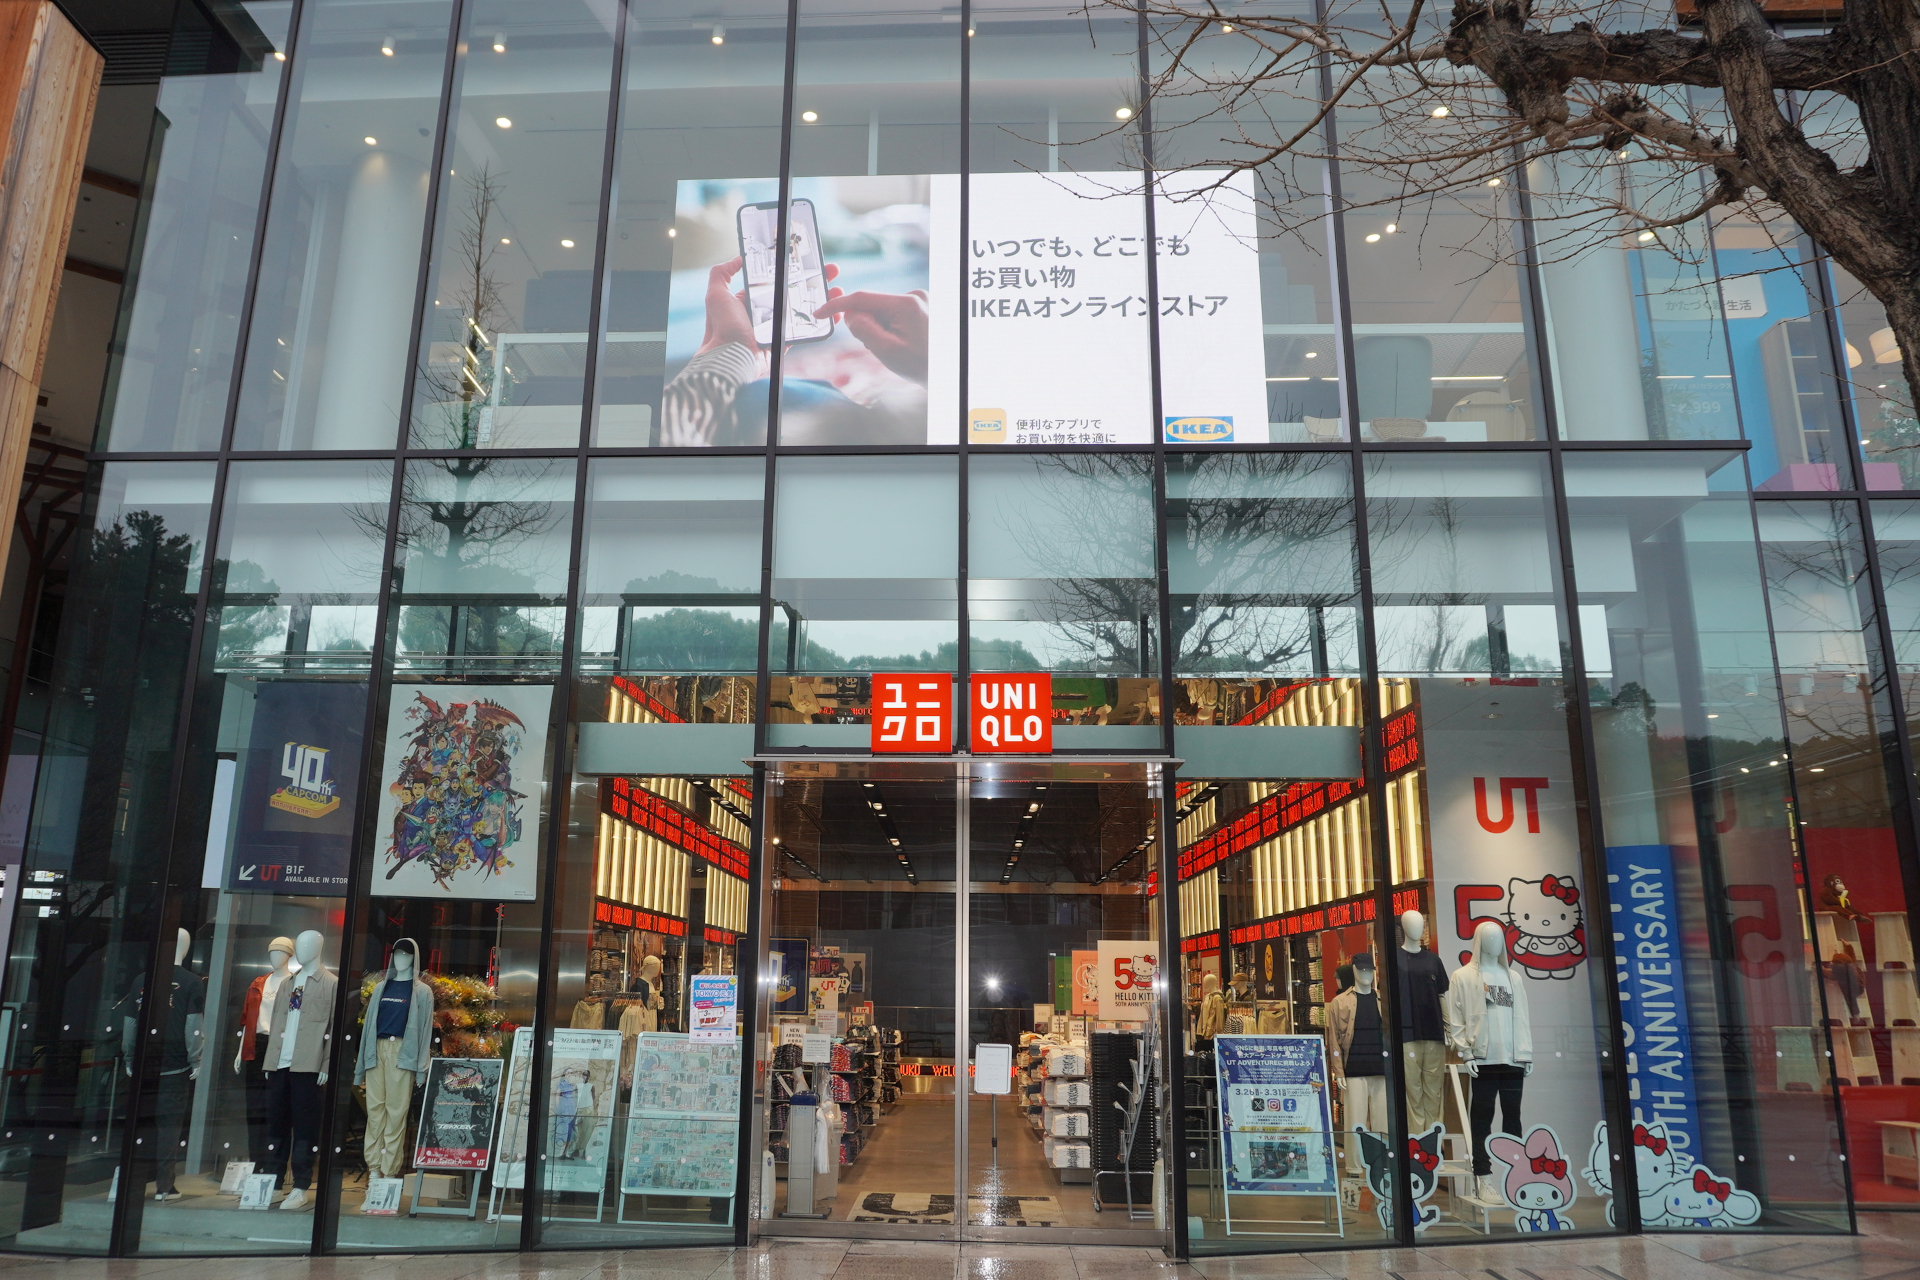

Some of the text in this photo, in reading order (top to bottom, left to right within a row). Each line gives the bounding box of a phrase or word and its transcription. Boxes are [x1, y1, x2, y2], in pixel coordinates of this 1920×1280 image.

[971, 266, 1076, 289] お買い物
[971, 294, 1229, 318] IKEAオンラインストア
[975, 422, 1000, 430] IKEA
[1016, 418, 1102, 430] 便利なアプリで
[1171, 423, 1229, 435] IKEA
[1016, 432, 1117, 444] お買い物を快適に
[286, 785, 327, 804] CAPCOM
[1473, 777, 1549, 834] UT
[260, 865, 282, 882] UT
[285, 865, 305, 875] B1F
[284, 876, 321, 884] AVAILABLE
[1628, 864, 1684, 1081] ANNIVERSARY
[1115, 992, 1160, 1001] HELLO KITTY
